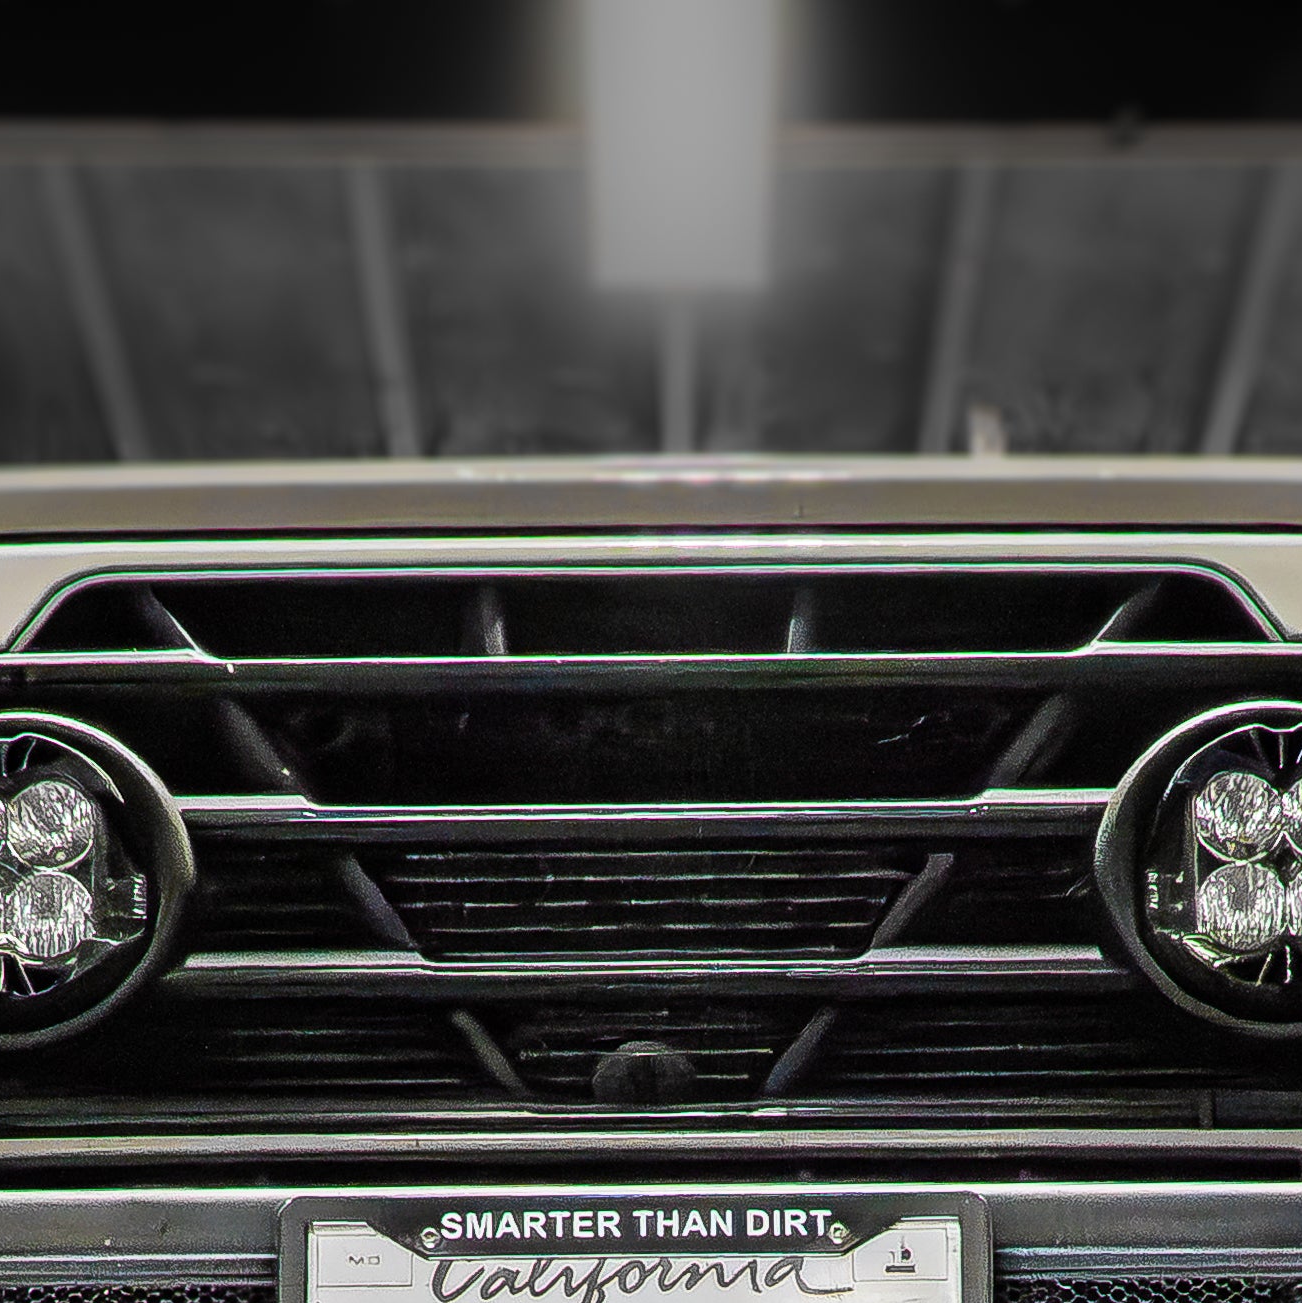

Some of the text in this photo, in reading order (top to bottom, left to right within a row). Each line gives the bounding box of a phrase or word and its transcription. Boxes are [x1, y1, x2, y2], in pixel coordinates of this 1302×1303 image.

[440, 1208, 833, 1240] SMARTER THAN DIRT
